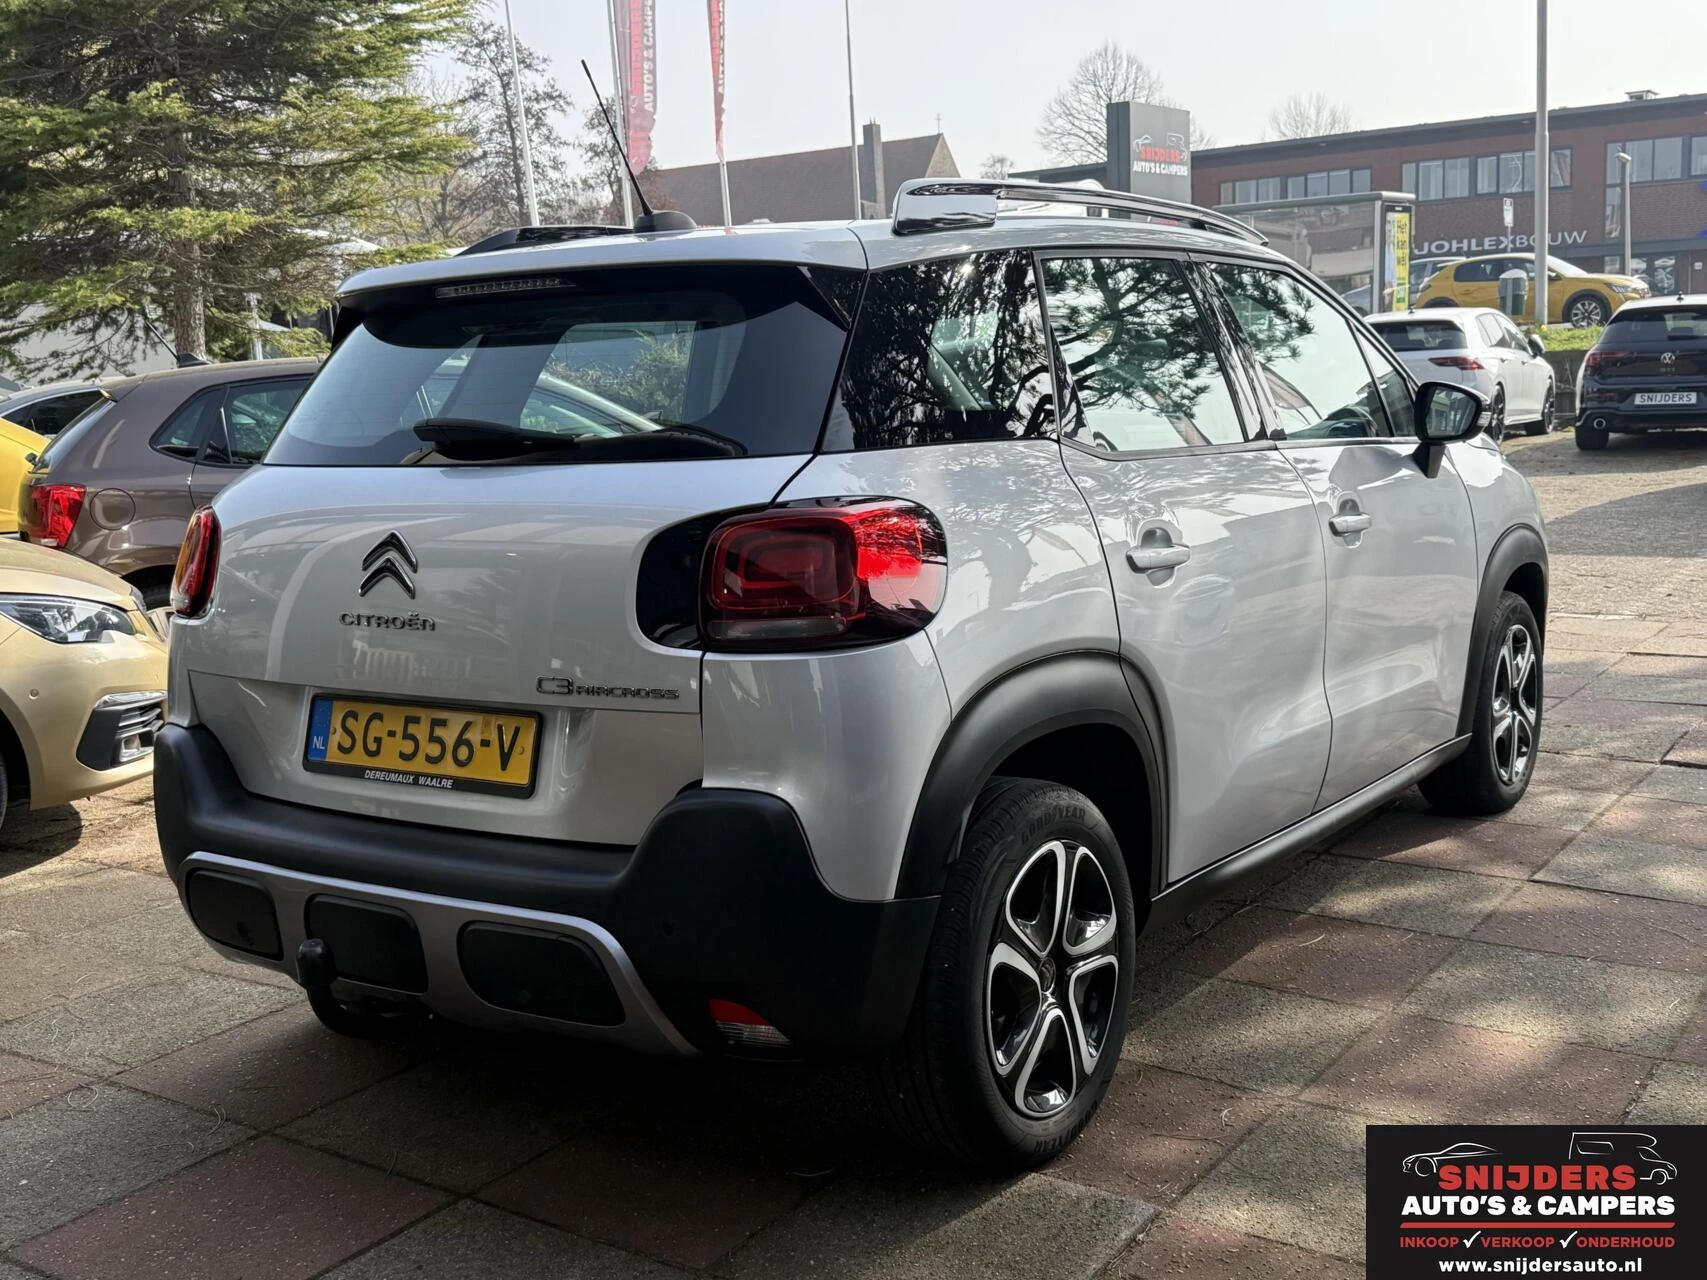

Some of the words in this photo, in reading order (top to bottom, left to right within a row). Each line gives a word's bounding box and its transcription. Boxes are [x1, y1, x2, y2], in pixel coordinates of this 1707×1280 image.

[643, 61, 654, 112] AUTO'S
[1132, 161, 1155, 173] AUTO'S
[1414, 230, 1588, 255] JOHLEXBUW
[1640, 393, 1692, 404] SNIJDERS
[536, 675, 574, 695] C3
[575, 684, 680, 700] AIRCROSS
[312, 735, 326, 750] NL
[337, 710, 520, 772] SG-556-V
[364, 770, 415, 785] DEREUMAUX
[417, 777, 454, 789] WAALRE
